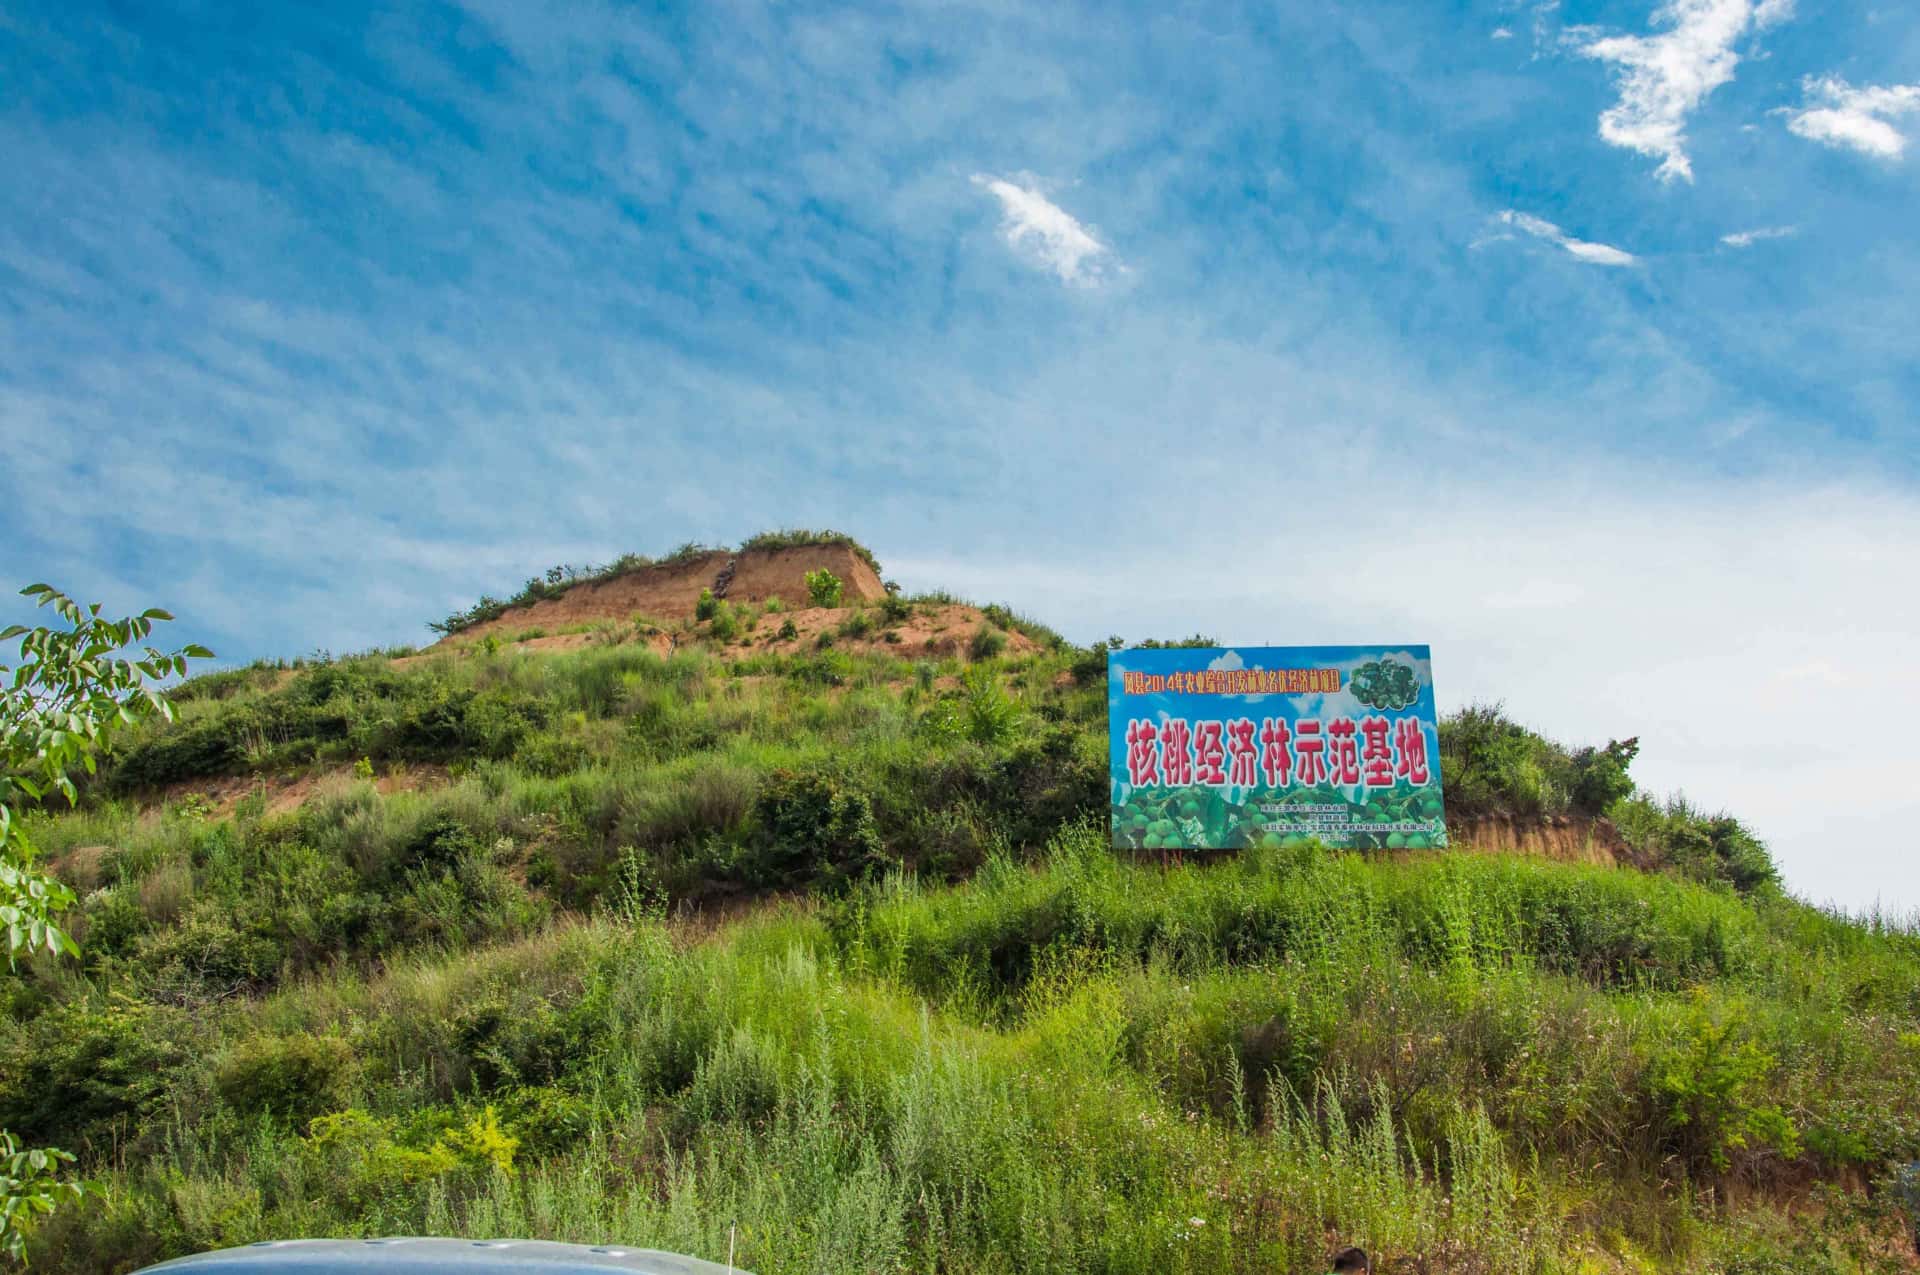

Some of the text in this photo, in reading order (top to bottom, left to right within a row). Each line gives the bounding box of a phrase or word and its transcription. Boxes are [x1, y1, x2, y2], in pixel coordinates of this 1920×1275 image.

[1126, 716, 1429, 788] 核桃经济林示范基地
